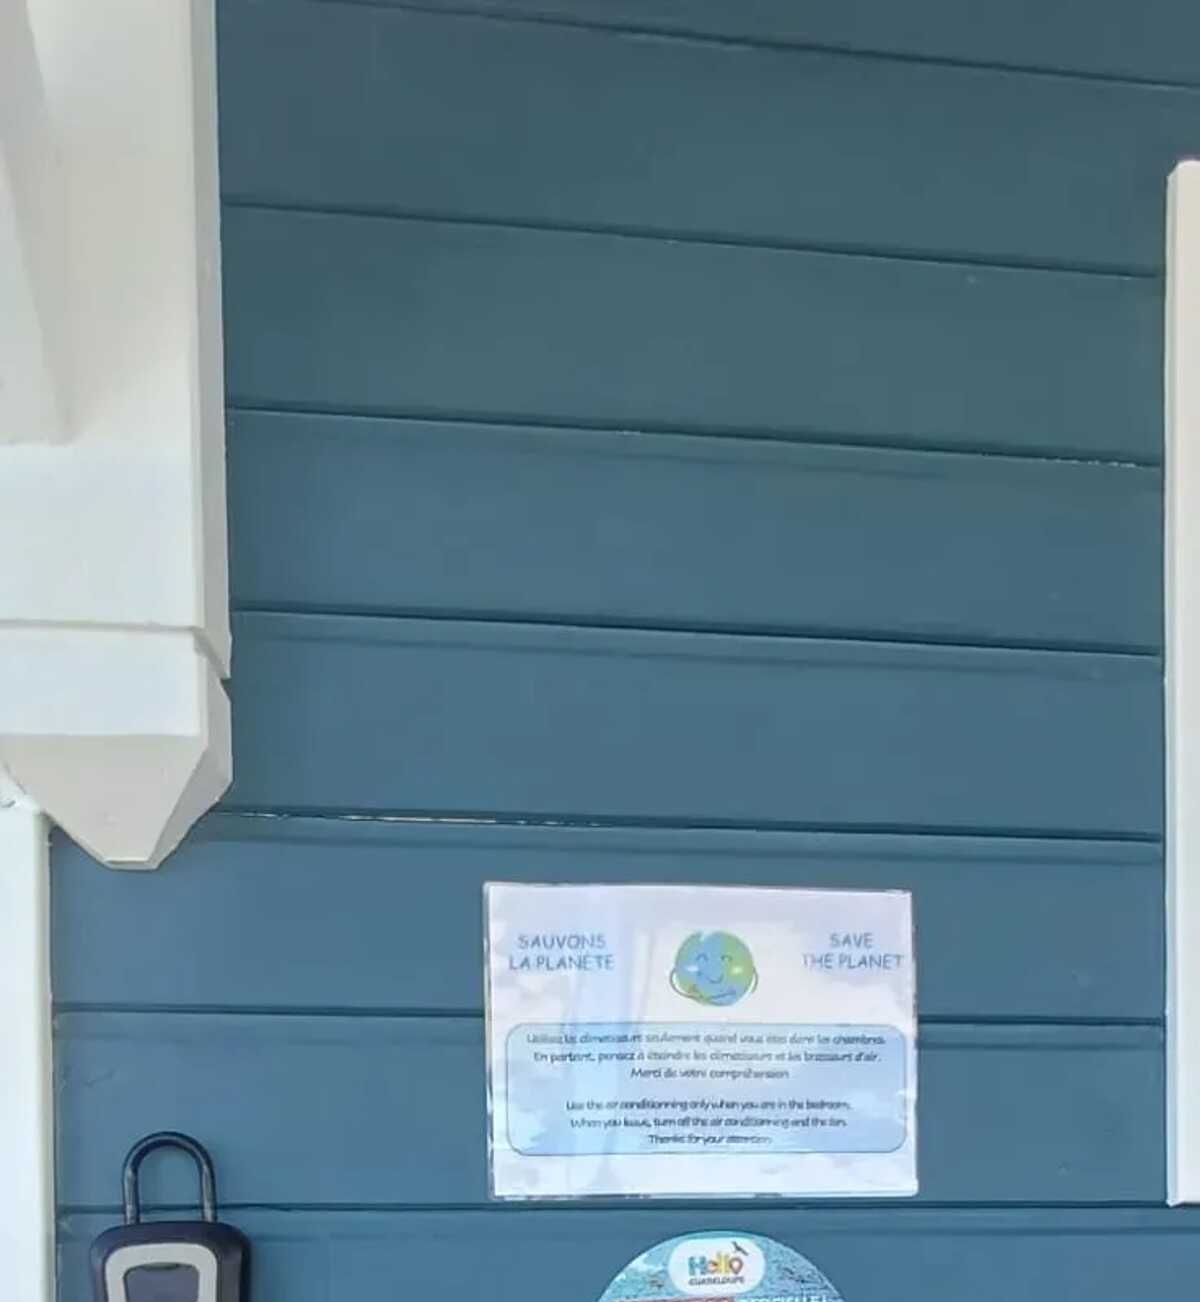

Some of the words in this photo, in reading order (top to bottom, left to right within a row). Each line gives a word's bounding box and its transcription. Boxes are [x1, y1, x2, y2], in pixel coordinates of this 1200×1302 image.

[518, 934, 607, 949] SAUVONS
[830, 932, 873, 949] SAVE
[509, 955, 530, 970] LA
[802, 953, 834, 969] THE
[839, 953, 904, 970] PLANET
[646, 1032, 700, 1043] seulement
[704, 1034, 737, 1046] quand
[740, 1035, 763, 1044] vous
[534, 1052, 548, 1061] En
[630, 1067, 661, 1078] Merci
[664, 1067, 677, 1078] de
[566, 1100, 584, 1110] Use
[587, 1099, 602, 1110] the
[741, 1101, 758, 1112] you
[760, 1101, 775, 1110] are
[777, 1099, 786, 1109] in
[788, 1099, 804, 1109] the
[570, 1118, 601, 1128] When
[603, 1119, 621, 1130] you
[654, 1118, 676, 1127] turn
[677, 1116, 691, 1127] off
[692, 1117, 708, 1127] the
[710, 1116, 722, 1127] air
[791, 1117, 810, 1127] and
[811, 1117, 827, 1127] the
[648, 1135, 685, 1144] Thanks
[687, 1133, 703, 1144] for
[704, 1136, 724, 1146] your
[688, 1251, 744, 1276] Hello
[688, 1276, 745, 1286] GUADELOUPE
